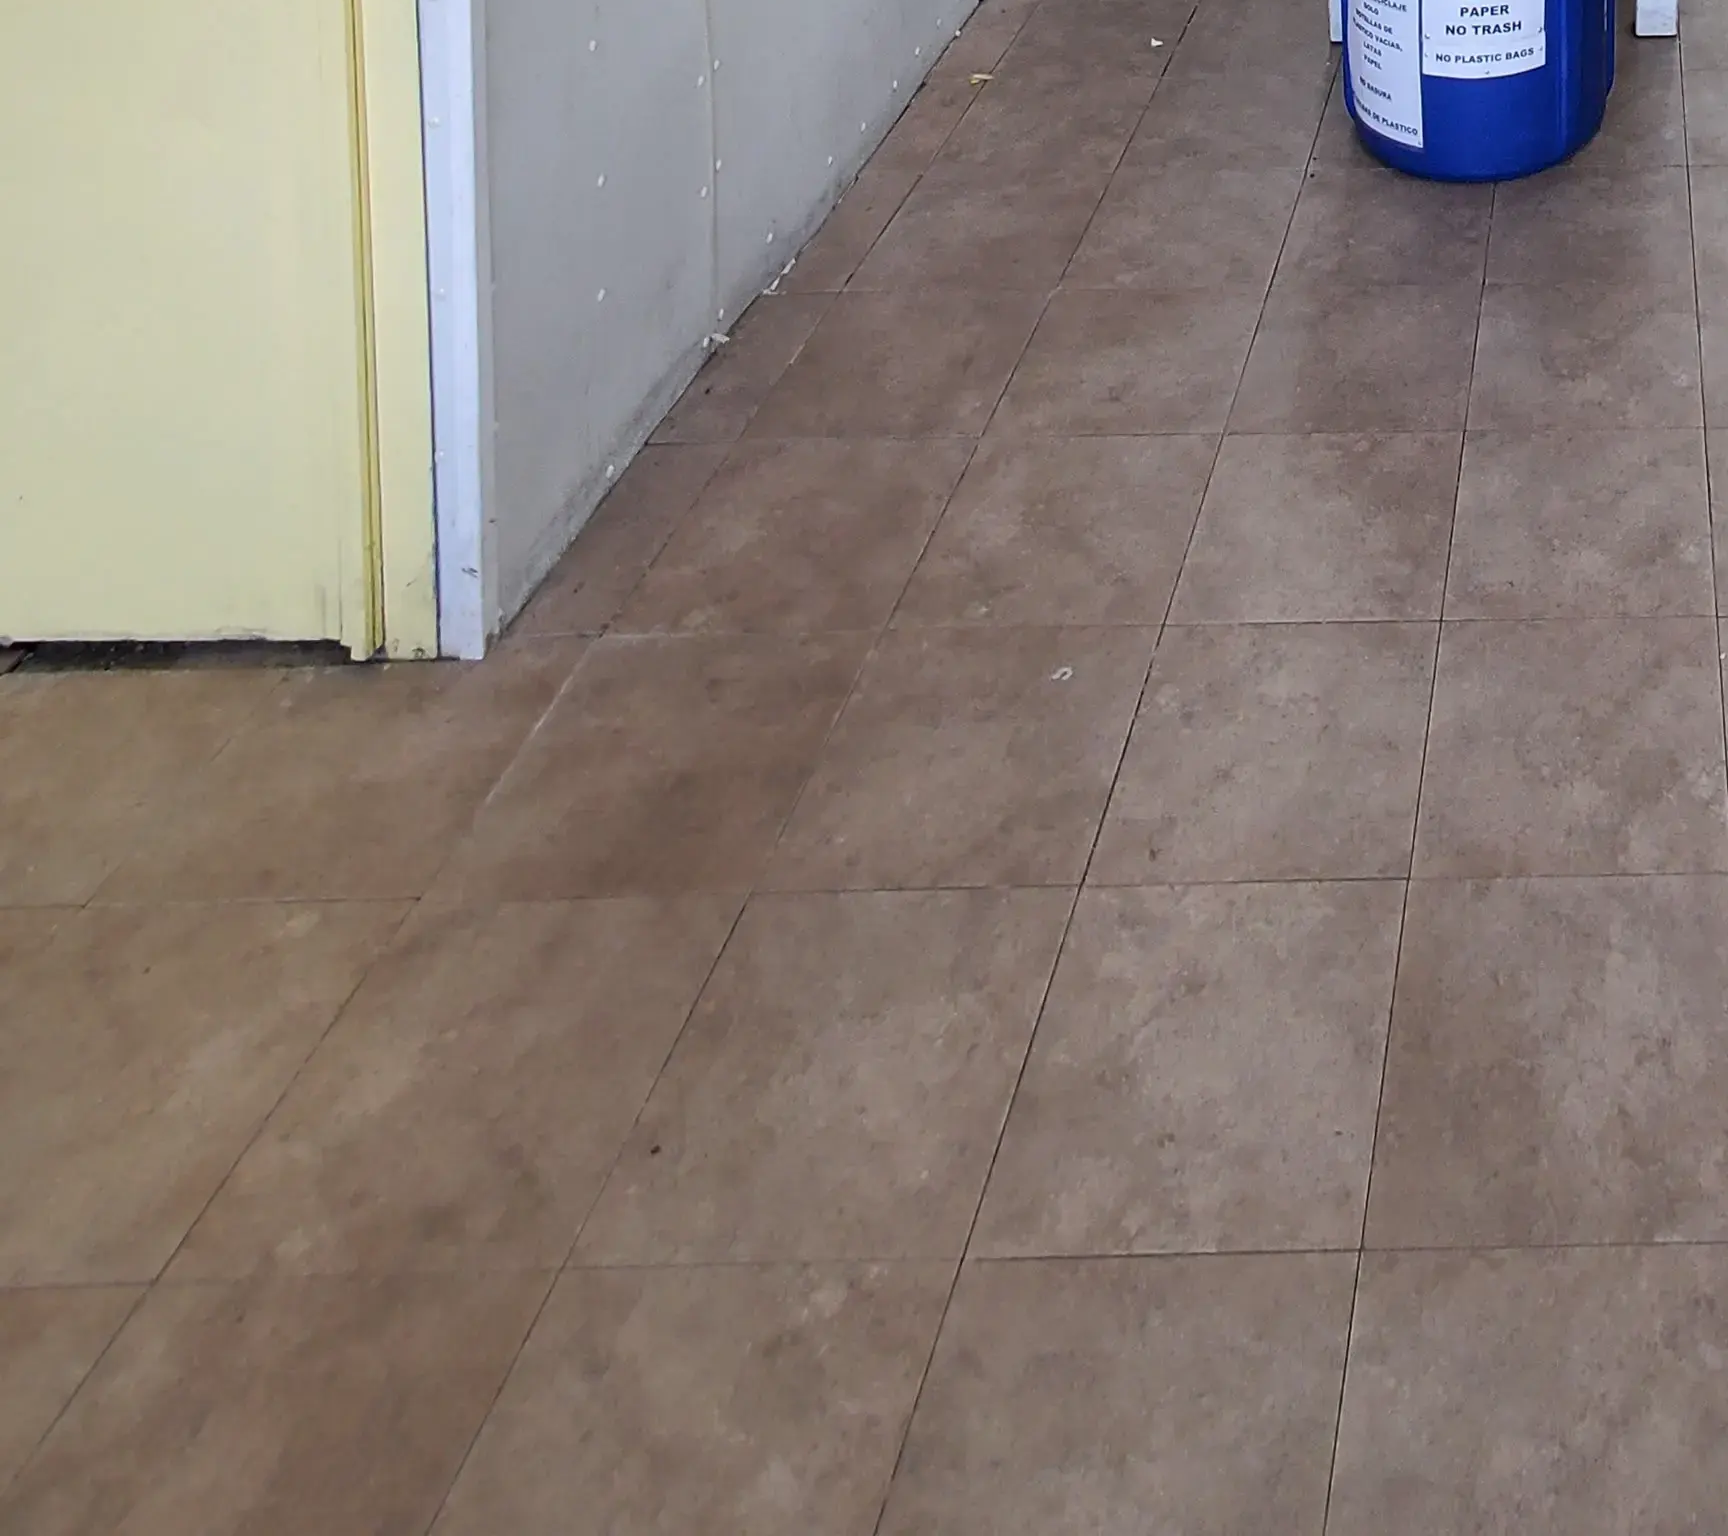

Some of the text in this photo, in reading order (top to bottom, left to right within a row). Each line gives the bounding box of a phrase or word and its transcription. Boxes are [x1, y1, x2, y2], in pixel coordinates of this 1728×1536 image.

[1460, 4, 1510, 18] PAPER
[1445, 20, 1522, 36] NO TRASH
[1435, 47, 1535, 64] NO PLASTIC BAGS
[1381, 116, 1419, 137] PLASTICO
